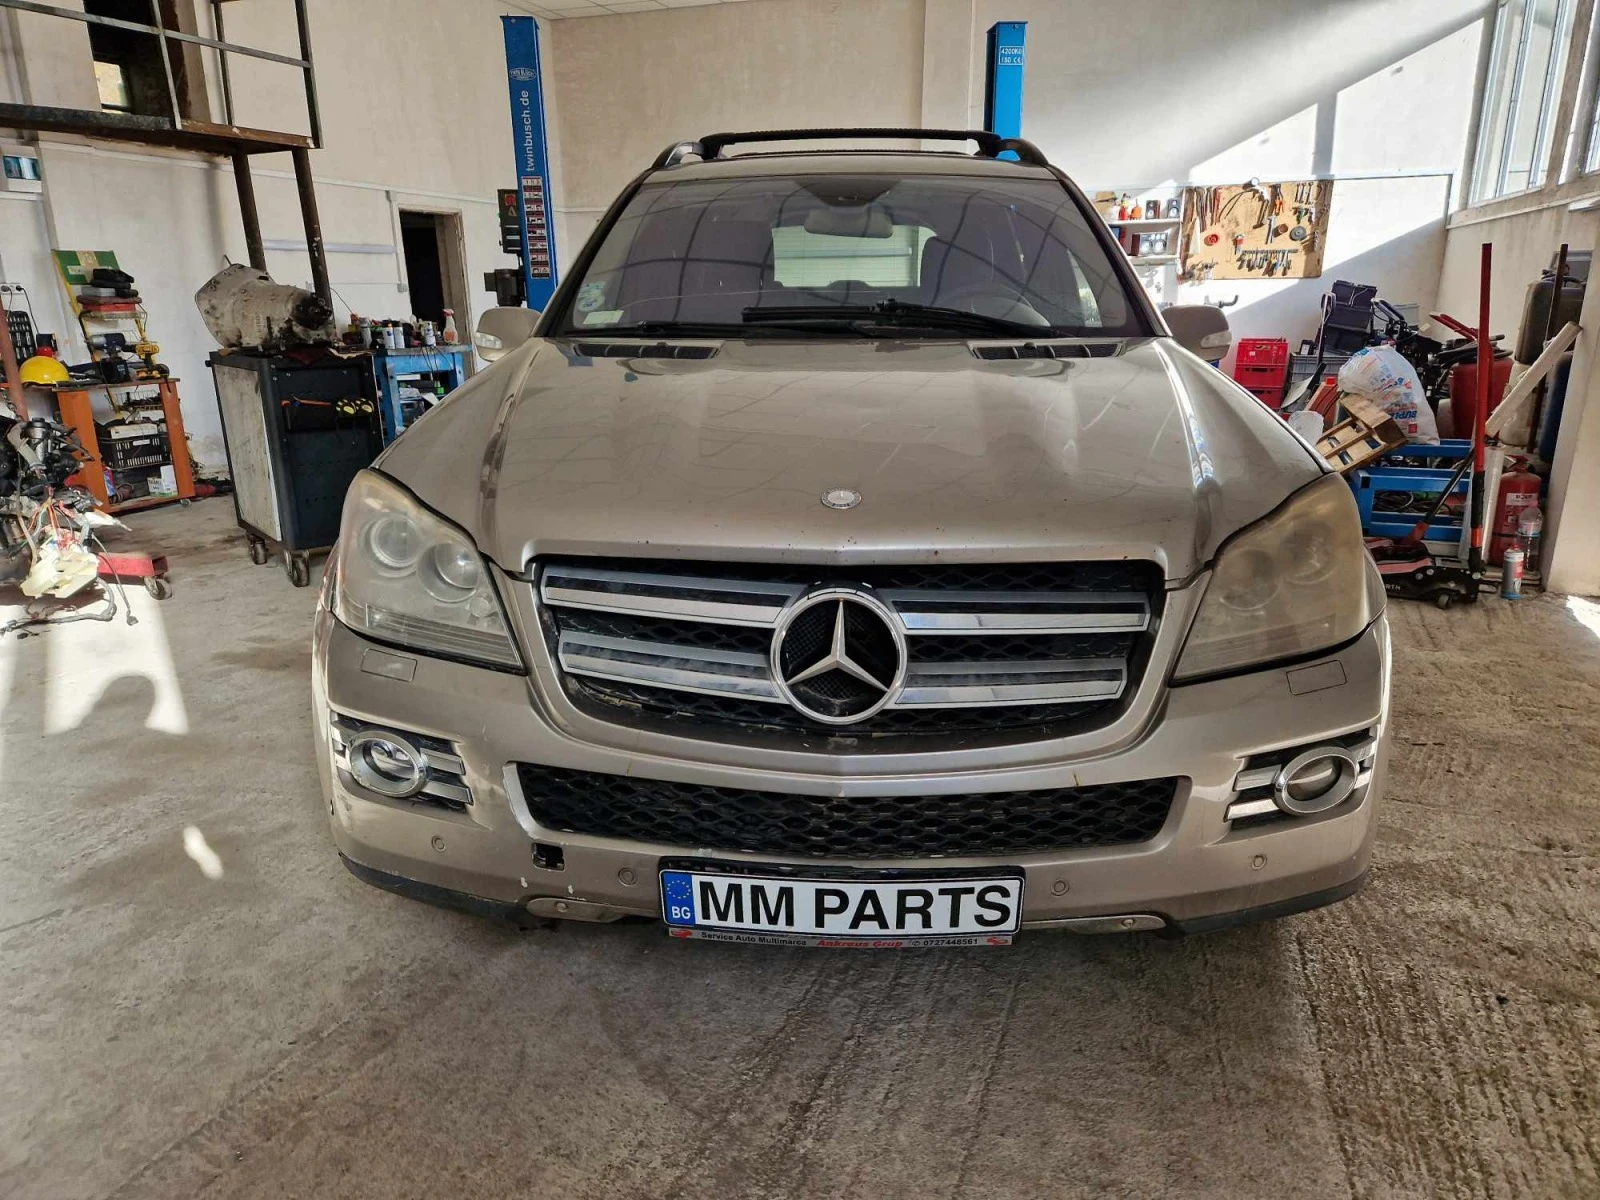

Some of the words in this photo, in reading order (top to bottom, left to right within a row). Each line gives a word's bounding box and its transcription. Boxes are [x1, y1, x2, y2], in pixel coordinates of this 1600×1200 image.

[520, 90, 535, 172] twinbusch.de
[671, 906, 691, 920] BG
[699, 881, 794, 927] MM
[814, 885, 1011, 930] PARTS
[701, 931, 734, 941] Service
[735, 934, 756, 943] Auto
[758, 936, 807, 946] Multimarca
[872, 940, 904, 949] Grup
